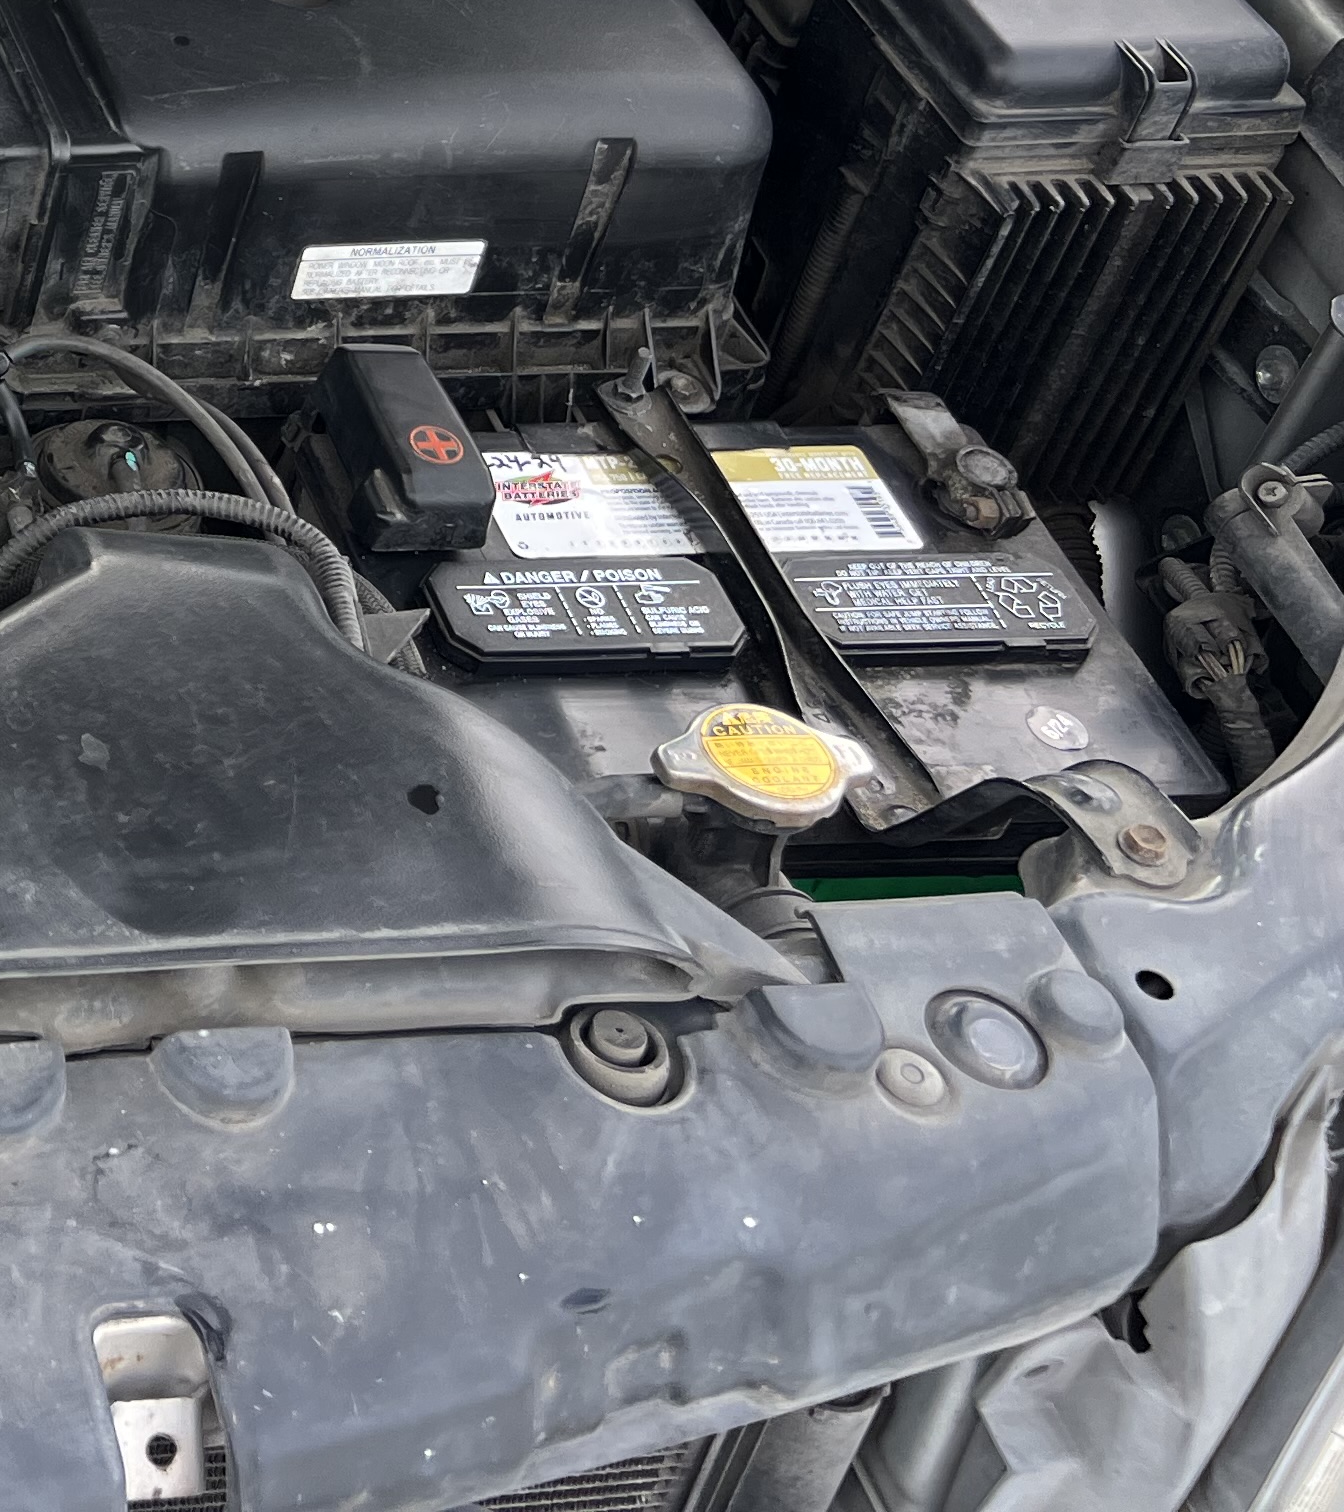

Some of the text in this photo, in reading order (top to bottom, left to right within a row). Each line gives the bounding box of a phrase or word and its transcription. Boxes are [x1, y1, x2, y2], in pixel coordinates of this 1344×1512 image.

[350, 245, 437, 257] NORMALIZATION
[583, 456, 638, 469] MTP-2
[770, 455, 865, 472] 30-MONTH
[496, 480, 581, 491] INTERSTATE
[503, 490, 578, 500] BATTERIES
[515, 510, 591, 522] AUTOMOTIVE
[499, 571, 578, 584] DANGER
[593, 568, 663, 582] POISON
[841, 579, 960, 590] FLUSH EYES IMMEDIATELY
[516, 592, 552, 600] SHIELD
[846, 590, 873, 599] WITH
[520, 600, 548, 608] EYES
[852, 598, 895, 607] MEDICAL
[894, 597, 919, 606] HELP
[502, 607, 556, 616] EXPLOSIVE
[588, 607, 606, 616] NO
[640, 605, 711, 615] SULFURIC ACID
[506, 615, 541, 624] GASES
[1027, 621, 1067, 629] RECYCLE
[712, 724, 798, 736] CAUTION
[1039, 712, 1075, 741] 6/24
[751, 766, 811, 776] ENGINE
[751, 775, 820, 785] COOLANT
